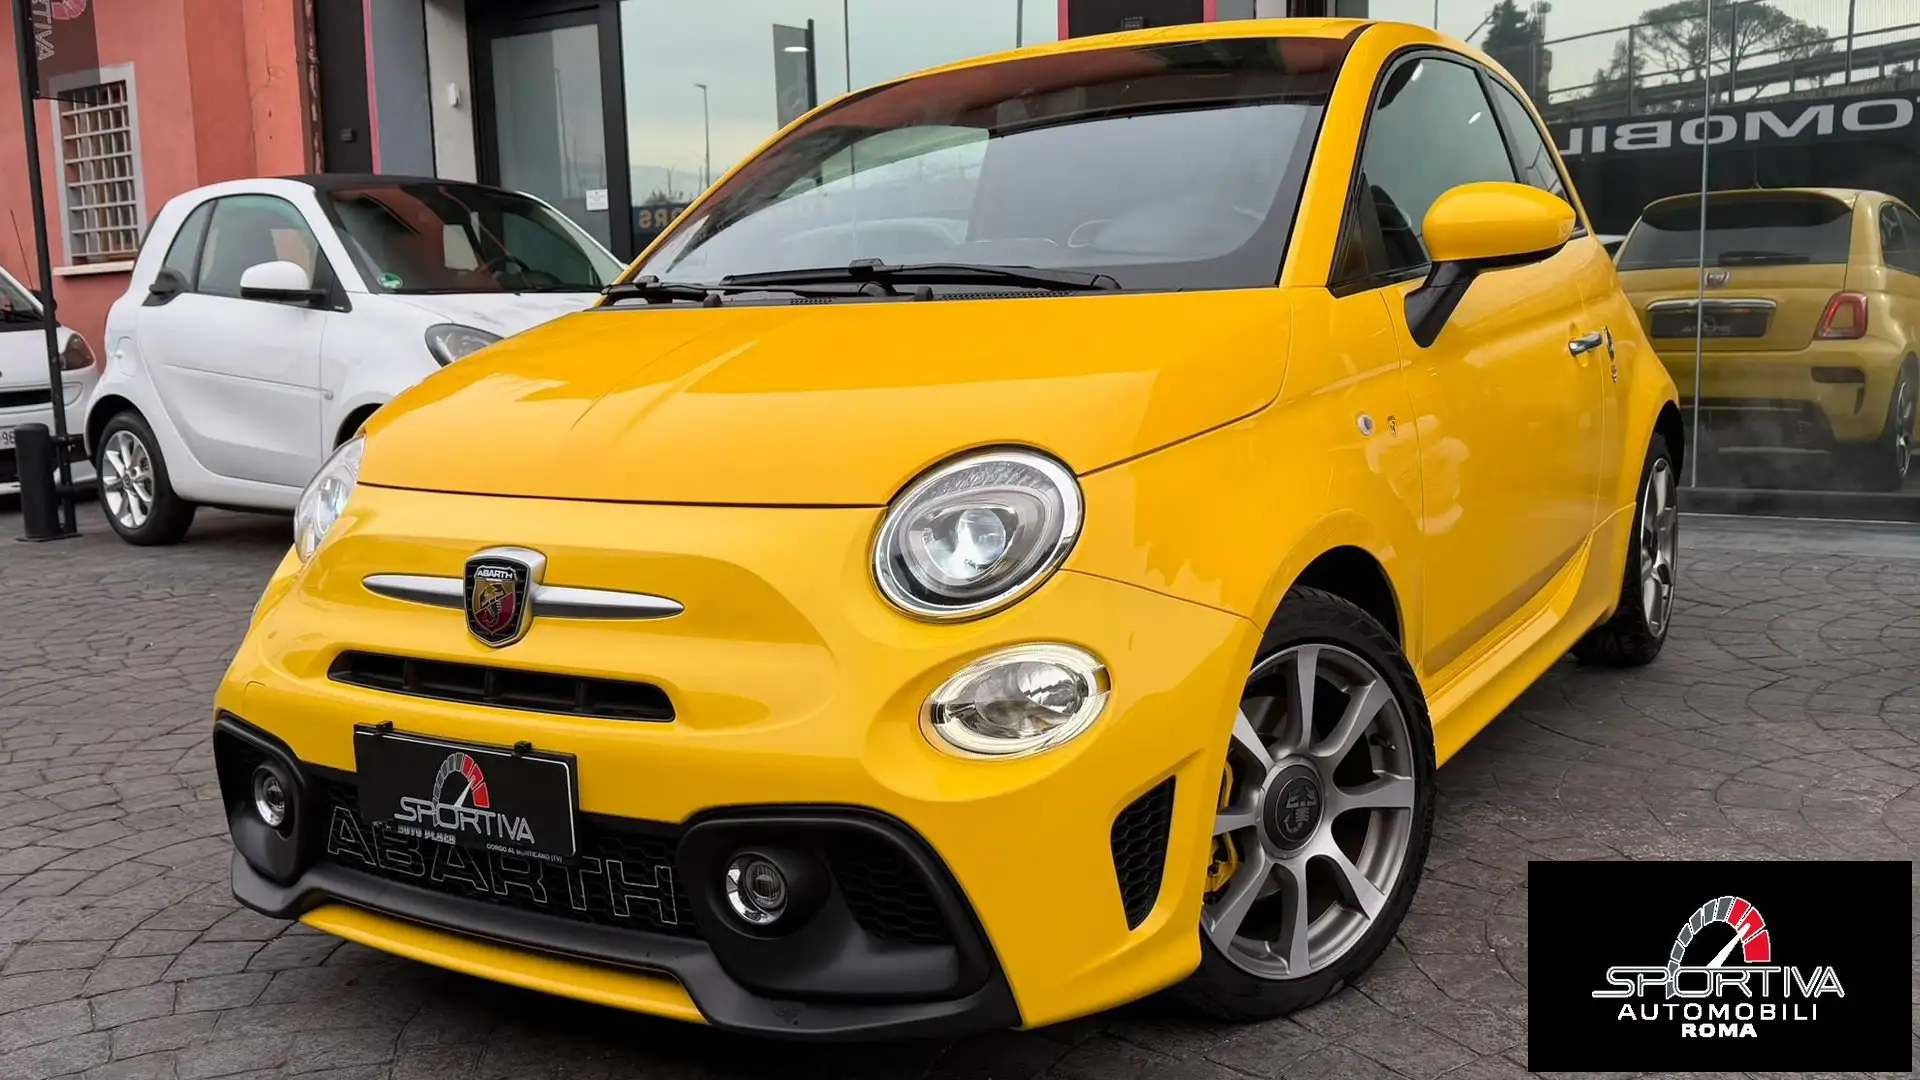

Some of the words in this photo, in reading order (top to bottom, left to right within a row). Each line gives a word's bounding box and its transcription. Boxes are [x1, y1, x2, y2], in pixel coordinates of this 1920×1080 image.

[31, 0, 55, 60] TIVA
[477, 569, 513, 579] ABARTH
[394, 796, 536, 844] SPORTIVA
[327, 805, 678, 925] ABARTH
